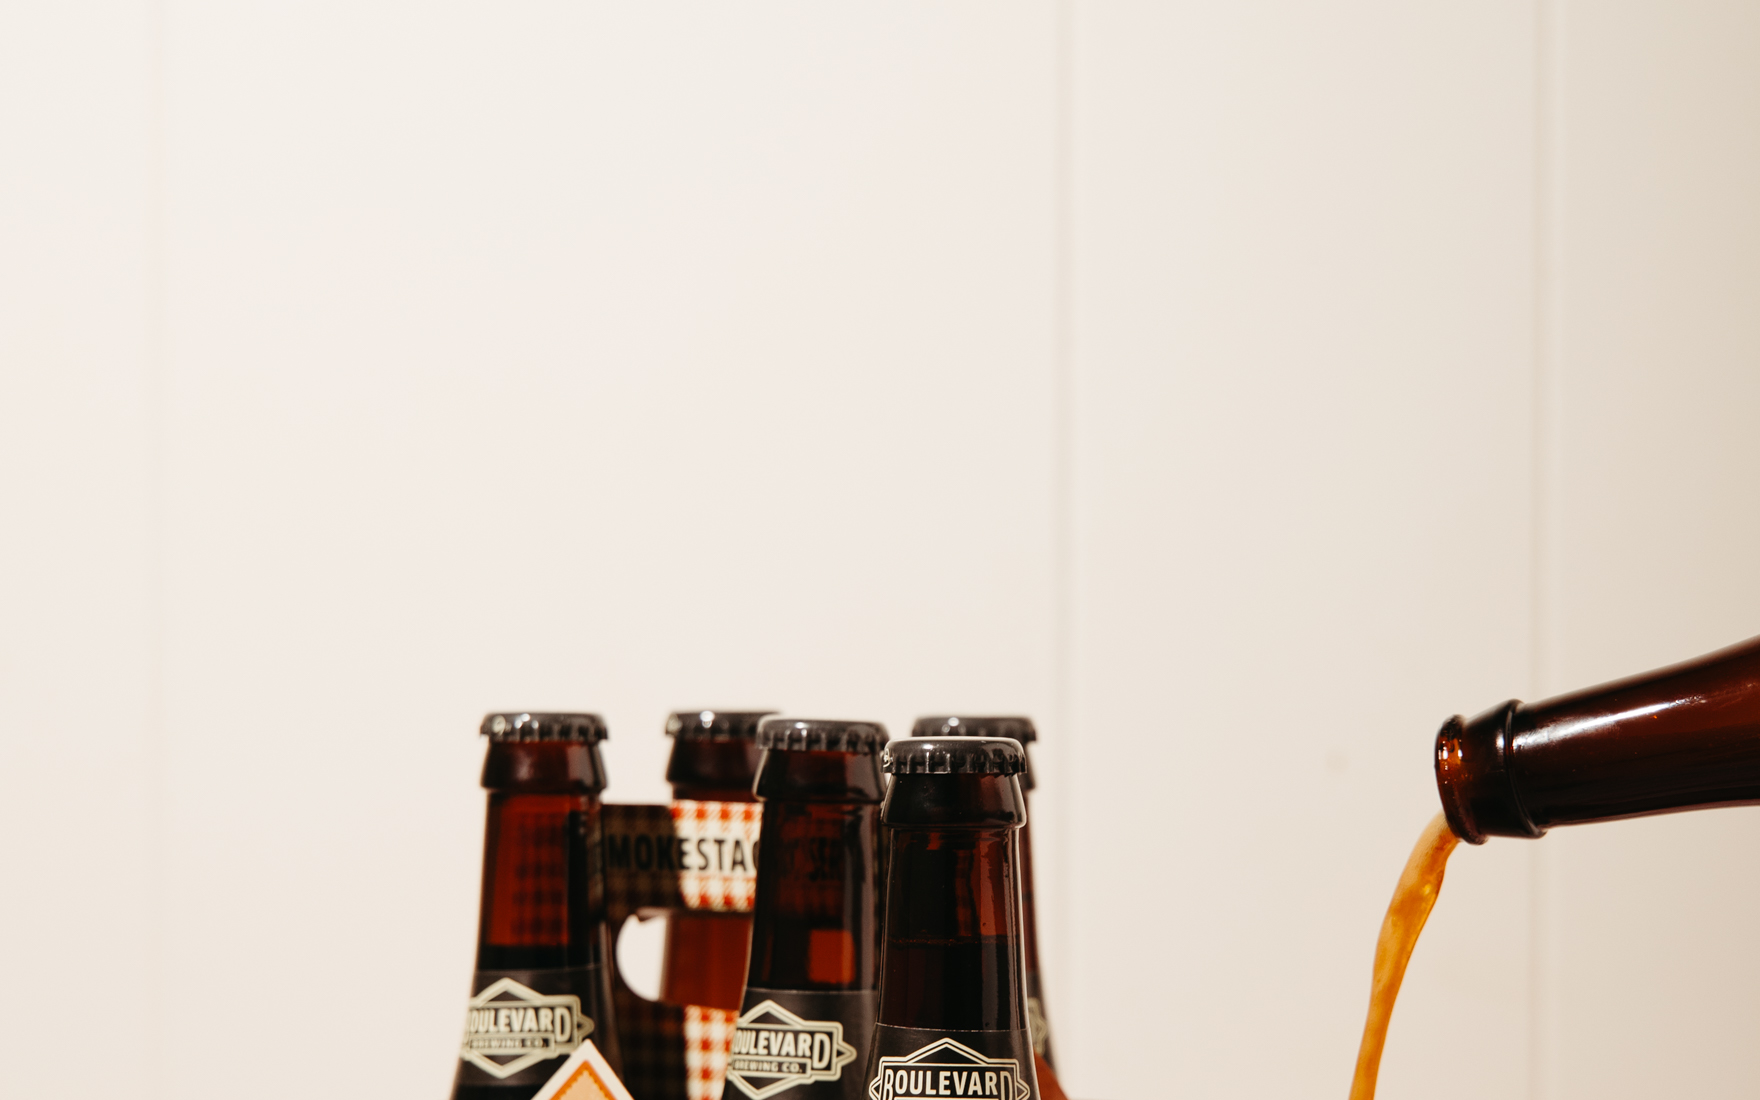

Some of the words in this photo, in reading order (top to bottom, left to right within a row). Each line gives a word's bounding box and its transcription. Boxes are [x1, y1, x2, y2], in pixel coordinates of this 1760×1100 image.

[465, 1006, 572, 1042] OULEVARD
[733, 1030, 831, 1069] OULEVARD
[781, 1062, 803, 1073] CO.
